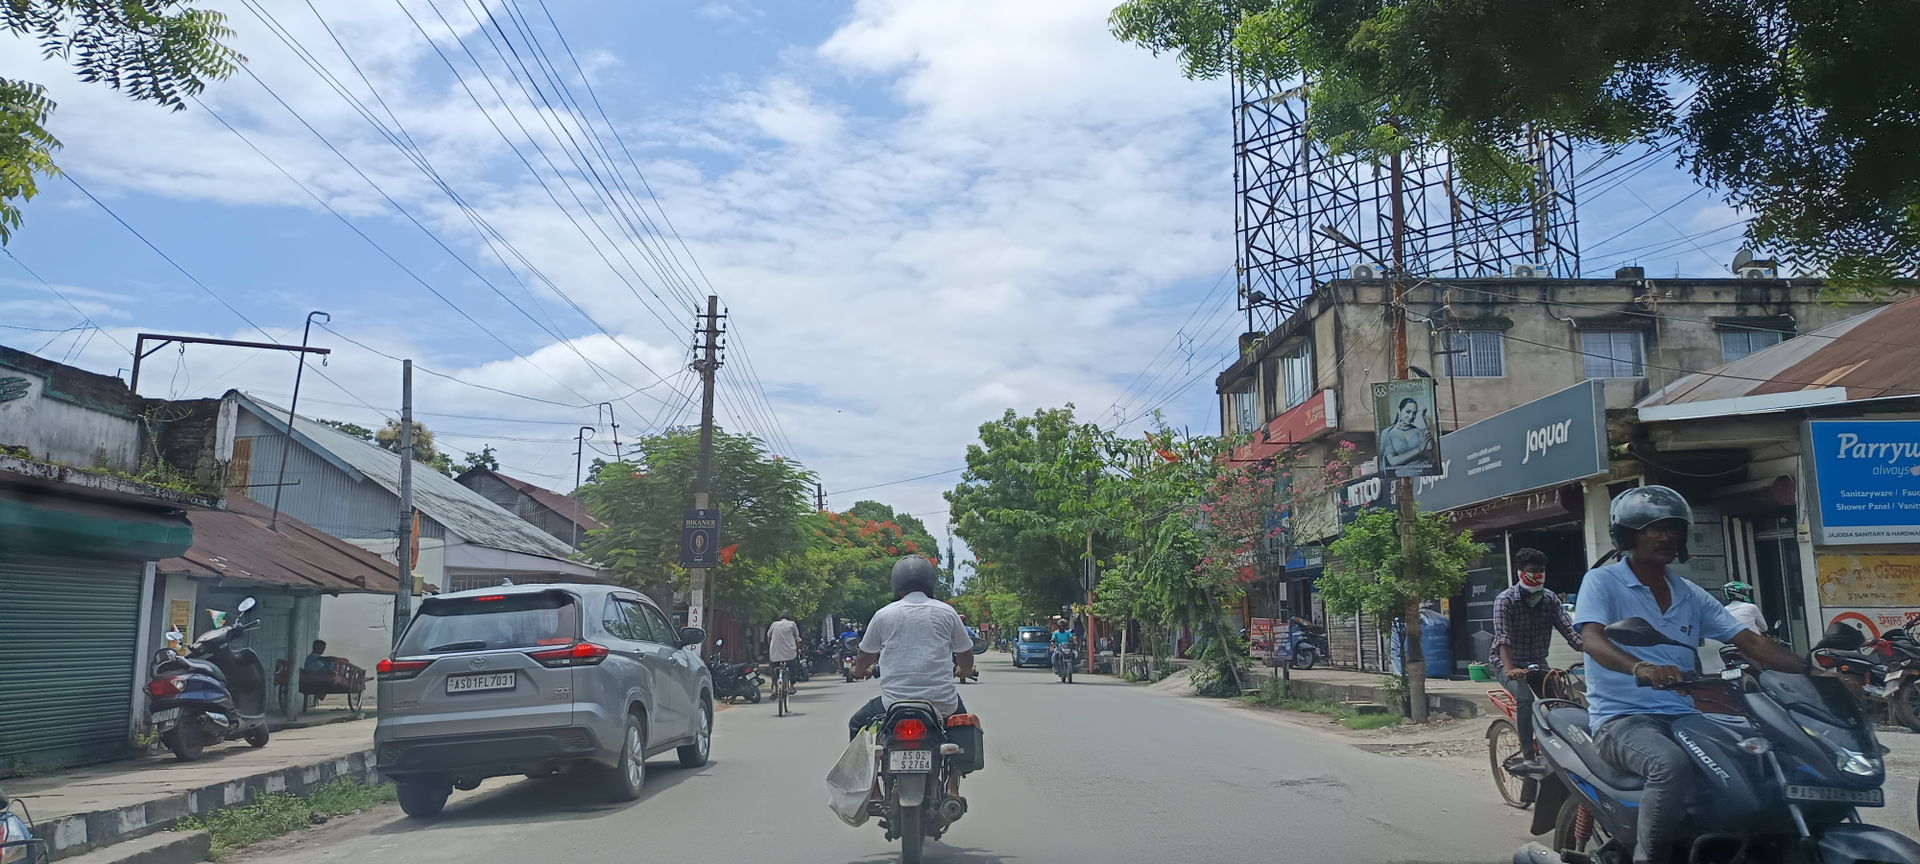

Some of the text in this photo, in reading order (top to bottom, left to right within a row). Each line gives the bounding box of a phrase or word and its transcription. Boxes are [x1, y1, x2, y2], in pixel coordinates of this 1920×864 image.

[1872, 464, 1910, 478] always
[1840, 489, 1893, 499] Sanitaryware
[1836, 503, 1866, 511] Shower
[1868, 502, 1891, 510] Panel
[454, 674, 513, 690] AS01FL7031
[903, 752, 926, 760] AS 02
[1677, 730, 1731, 788] GLAMOUR
